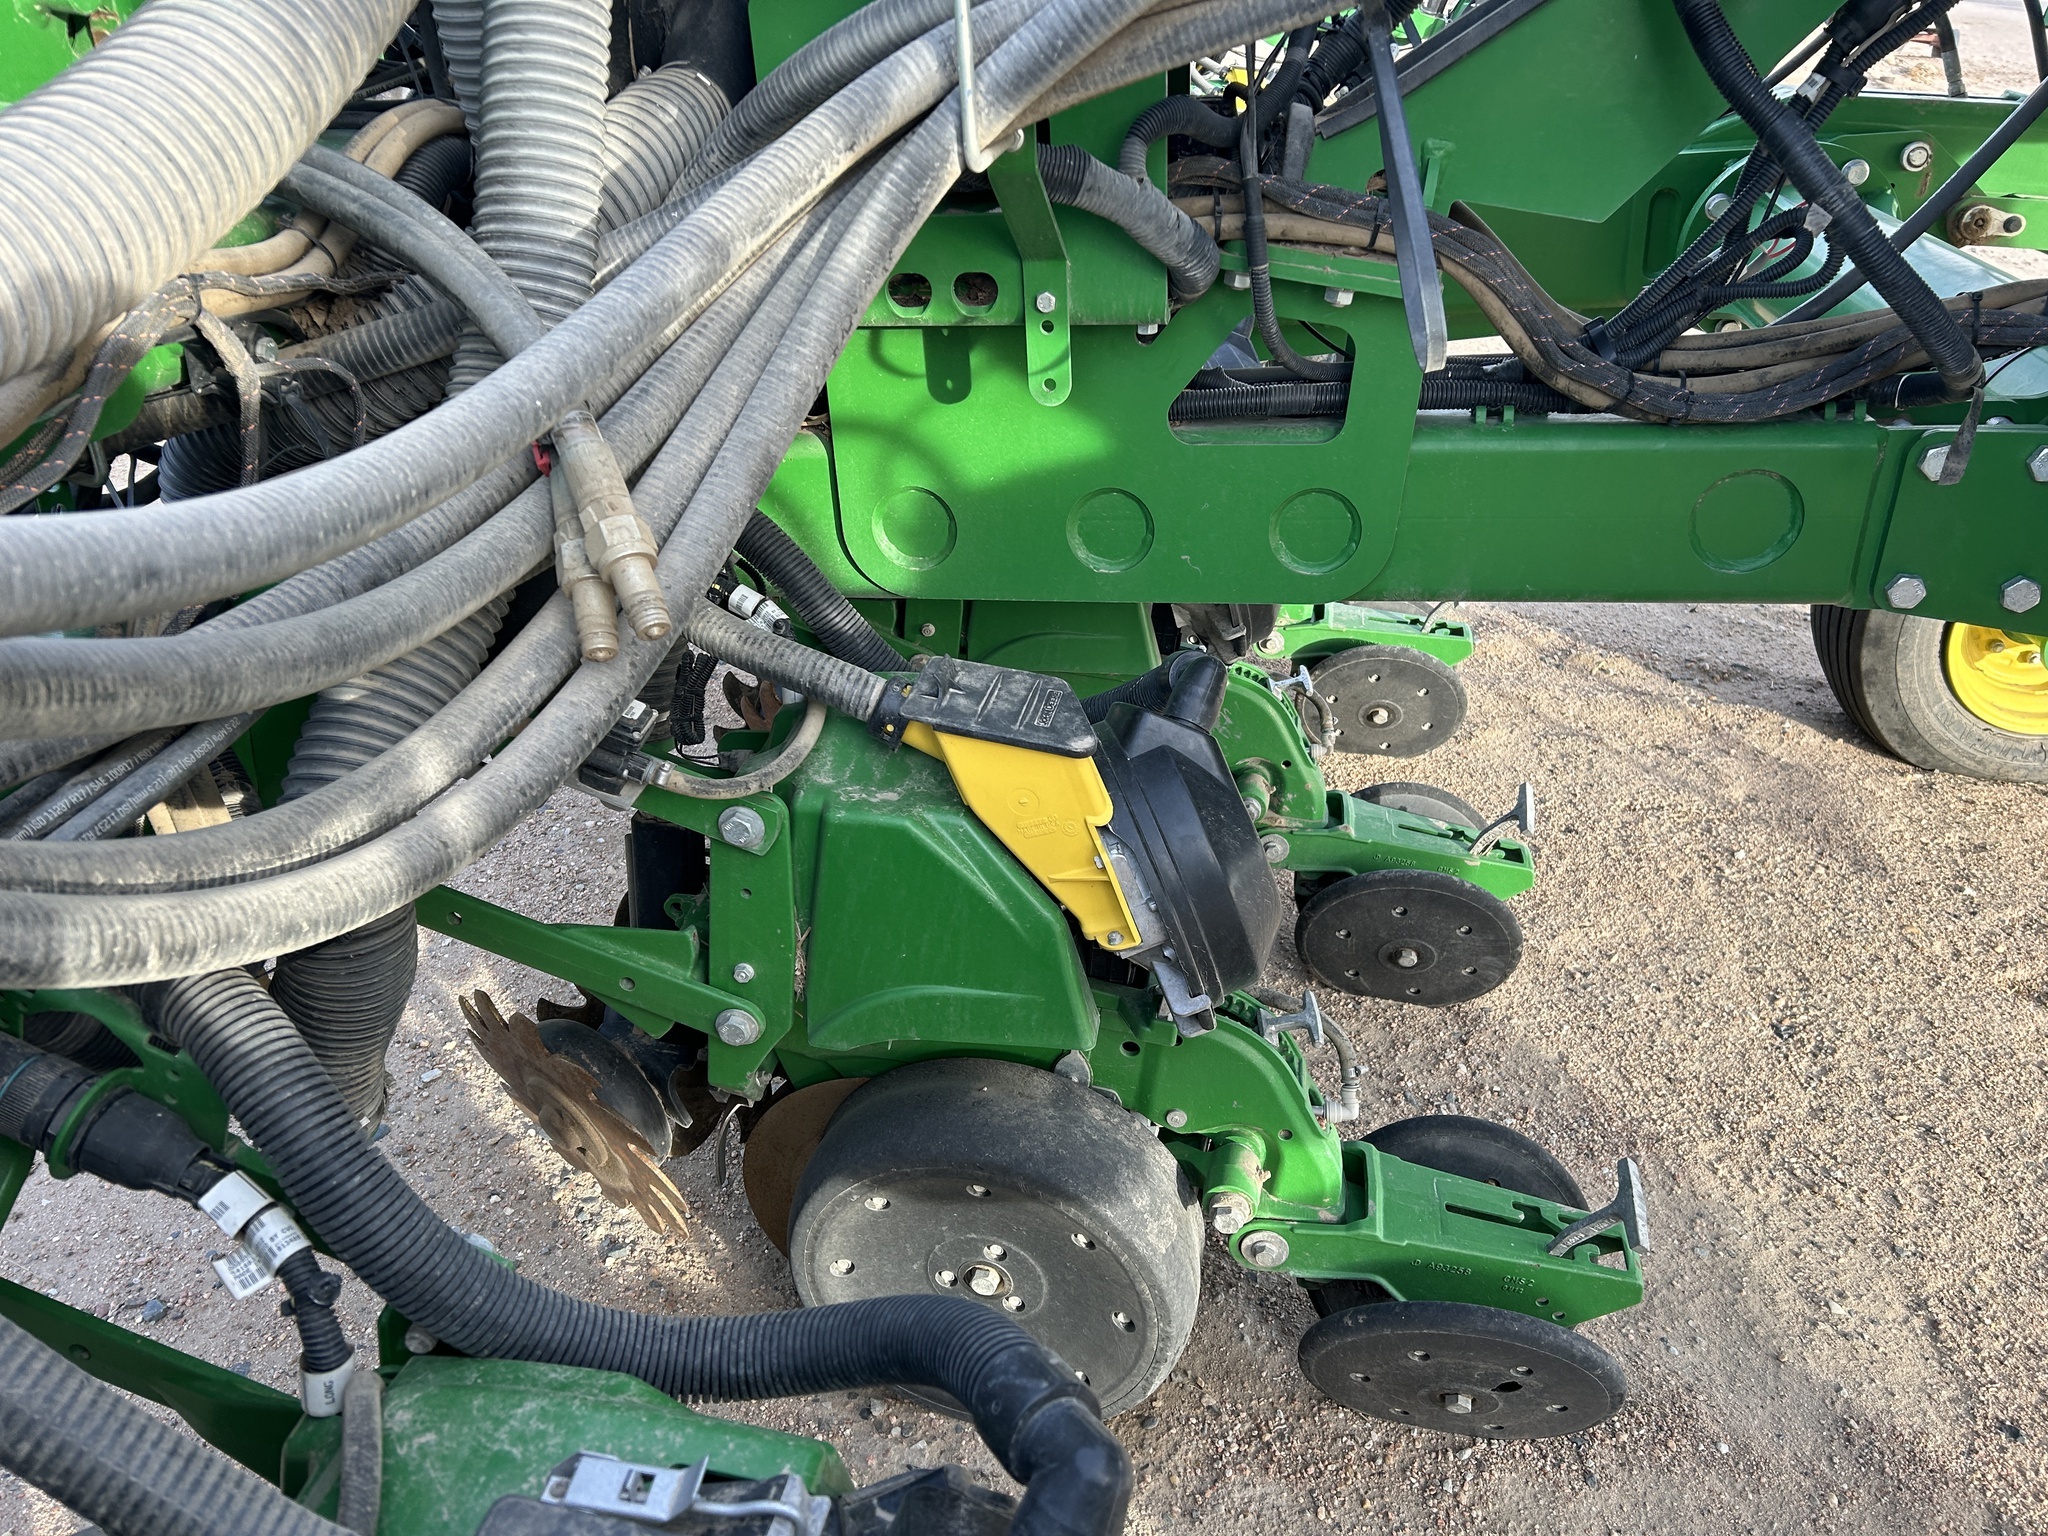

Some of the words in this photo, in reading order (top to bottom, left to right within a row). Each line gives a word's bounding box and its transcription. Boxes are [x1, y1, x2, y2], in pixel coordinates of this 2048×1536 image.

[211, 728, 227, 742] MPa
[194, 738, 215, 760] (3250
[179, 754, 198, 771] PSI)
[29, 816, 46, 832] ISO
[44, 799, 71, 820] 11237
[69, 787, 88, 804] R17
[89, 776, 108, 792] SAE
[105, 758, 136, 782] 100R17
[128, 789, 149, 809] mm)
[116, 800, 133, 818] ISO
[93, 812, 120, 837] 11237
[1427, 1261, 1472, 1276] A93258
[323, 1380, 336, 1405] LONG
